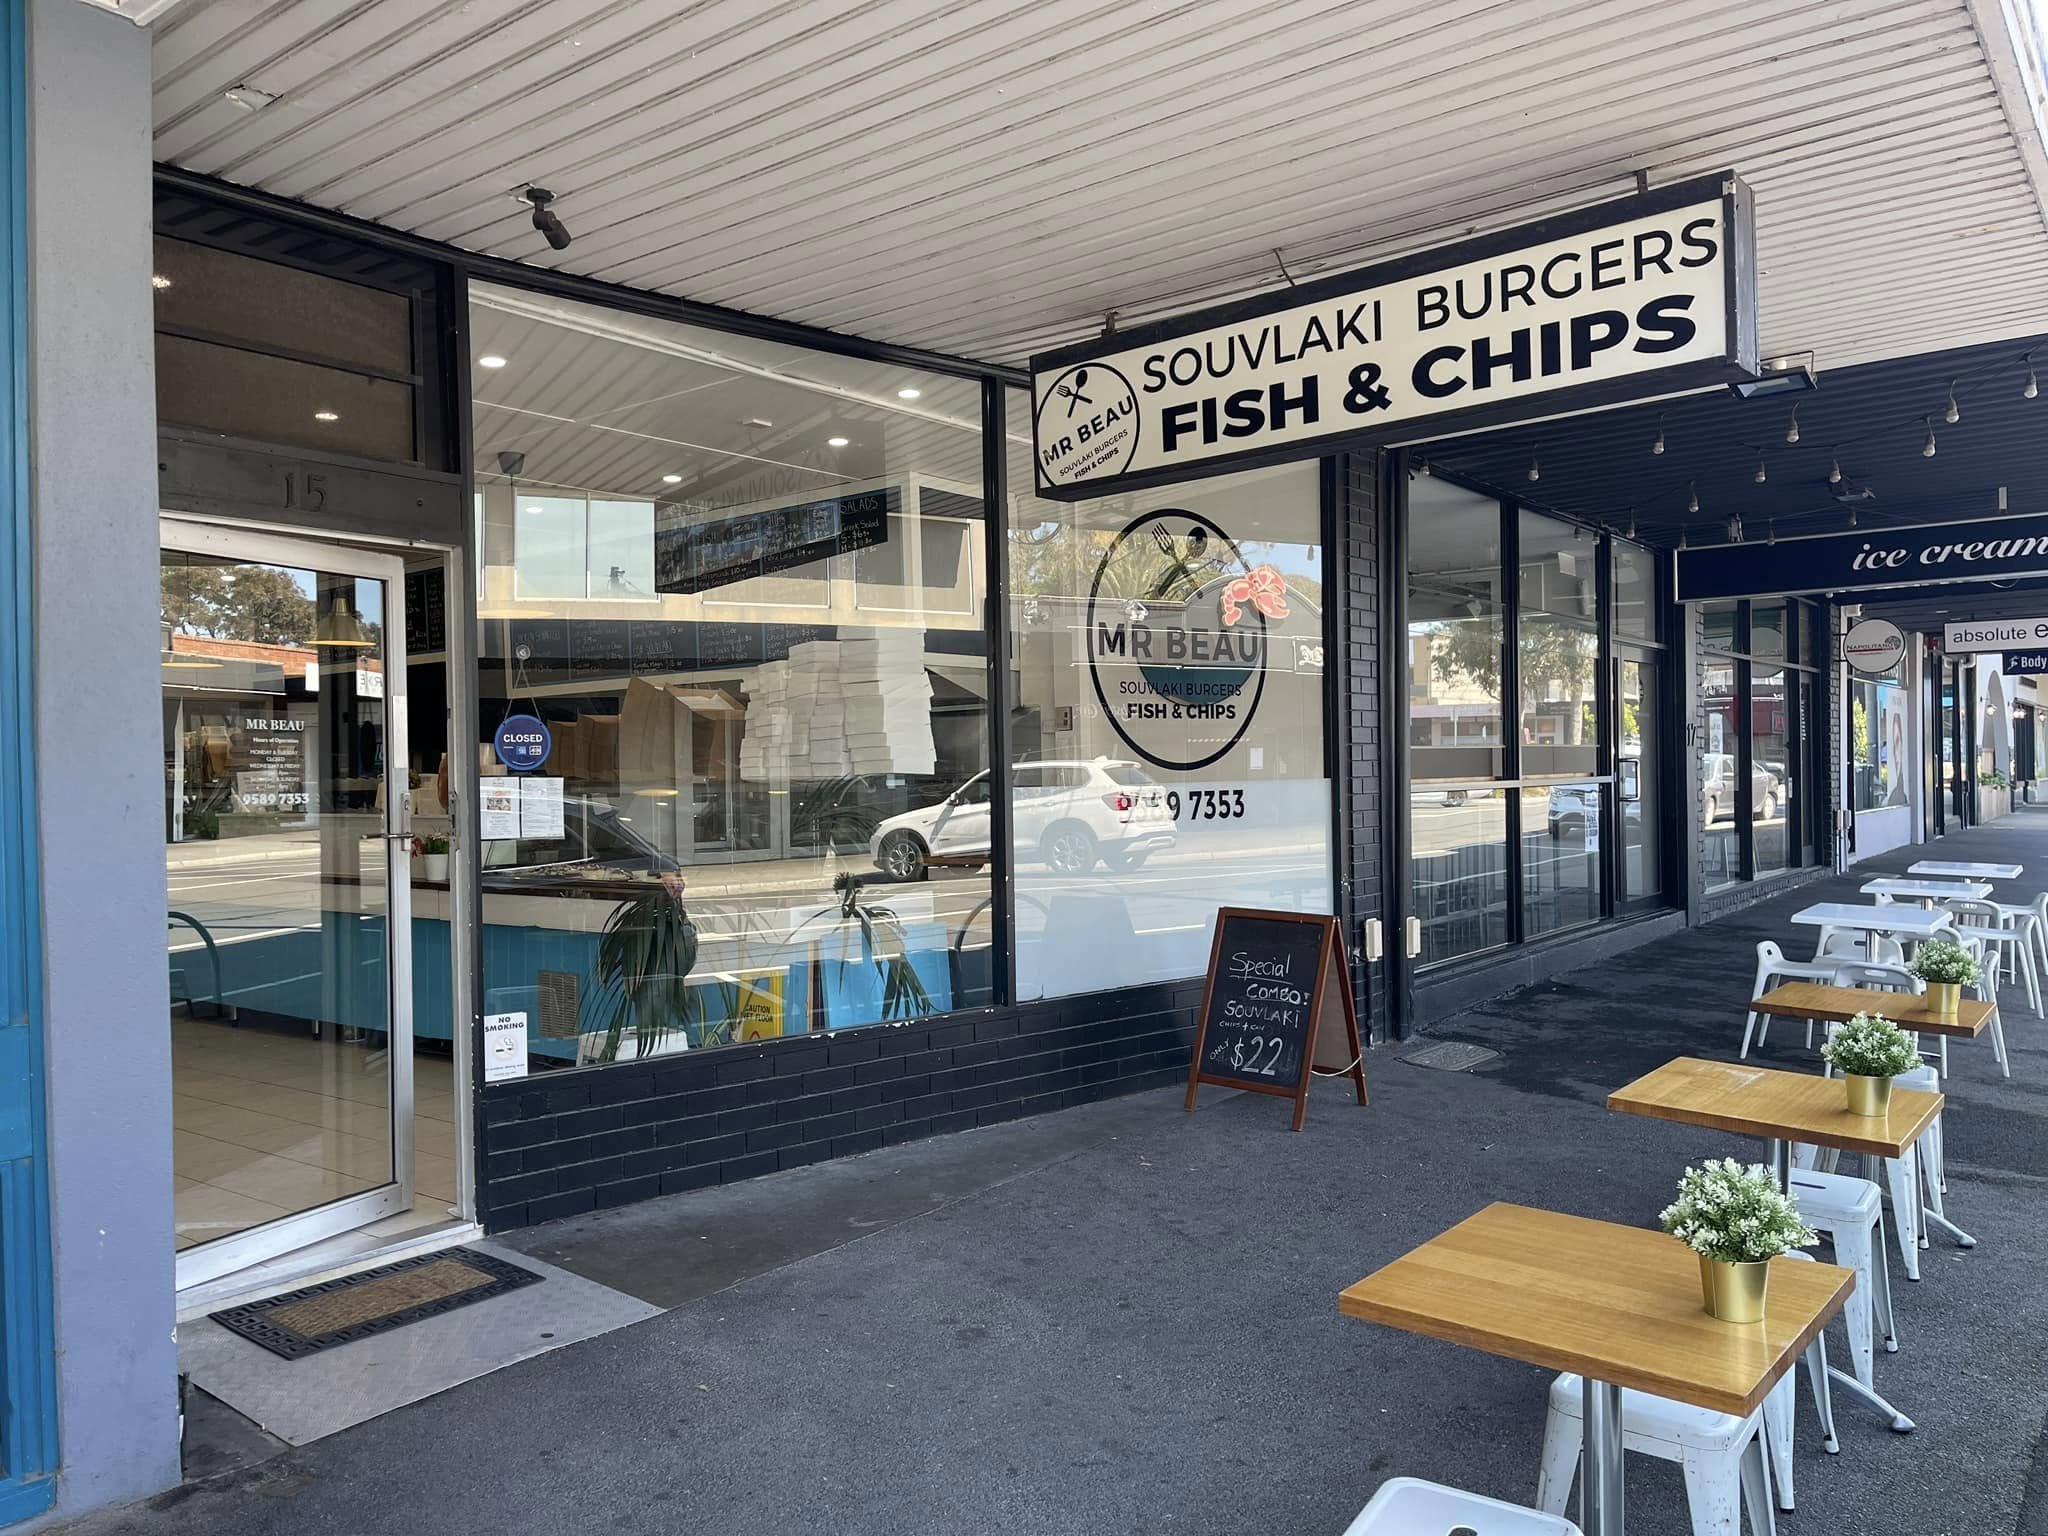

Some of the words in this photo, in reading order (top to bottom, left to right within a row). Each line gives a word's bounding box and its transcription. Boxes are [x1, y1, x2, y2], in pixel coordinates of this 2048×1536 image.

[1142, 300, 1382, 393] SOUVLAKI
[1417, 218, 1718, 332] BURGERS
[1161, 374, 1320, 453] FISH
[1343, 361, 1393, 416] &
[1412, 294, 1697, 398] CHIPS
[1042, 436, 1074, 466] MR
[1077, 395, 1133, 444] BEAU
[1059, 451, 1094, 477] SOUVLAKI
[1094, 429, 1128, 455] BURGERS
[1074, 466, 1092, 480] FISH
[1097, 447, 1120, 465] CHIPS
[282, 472, 328, 512] 15
[840, 496, 879, 513] SALADS
[1852, 544, 1911, 571] ice
[1920, 535, 2048, 566] cream
[1098, 622, 1152, 658] MR
[1166, 627, 1260, 663] BEAU
[1953, 626, 2027, 643] absolute
[2021, 655, 2047, 669] Body
[1119, 681, 1183, 697] SOUVLAKI
[1186, 683, 1242, 697] BURGERS
[1127, 703, 1167, 719] FISH
[1172, 703, 1183, 719] &
[1186, 703, 1236, 720] CHIPS
[245, 718, 268, 730] MR
[270, 719, 305, 732] BEAU
[503, 734, 543, 743] CLOSED
[278, 792, 310, 805] 7353
[1189, 789, 1245, 821] 7353
[1229, 952, 1291, 981] Special
[743, 1004, 771, 1014] CAUTION
[756, 1013, 774, 1023] FLOOR
[485, 1022, 525, 1032] SMOKING
[1209, 1037, 1229, 1060] ONLY
[1230, 1035, 1283, 1076] $22
